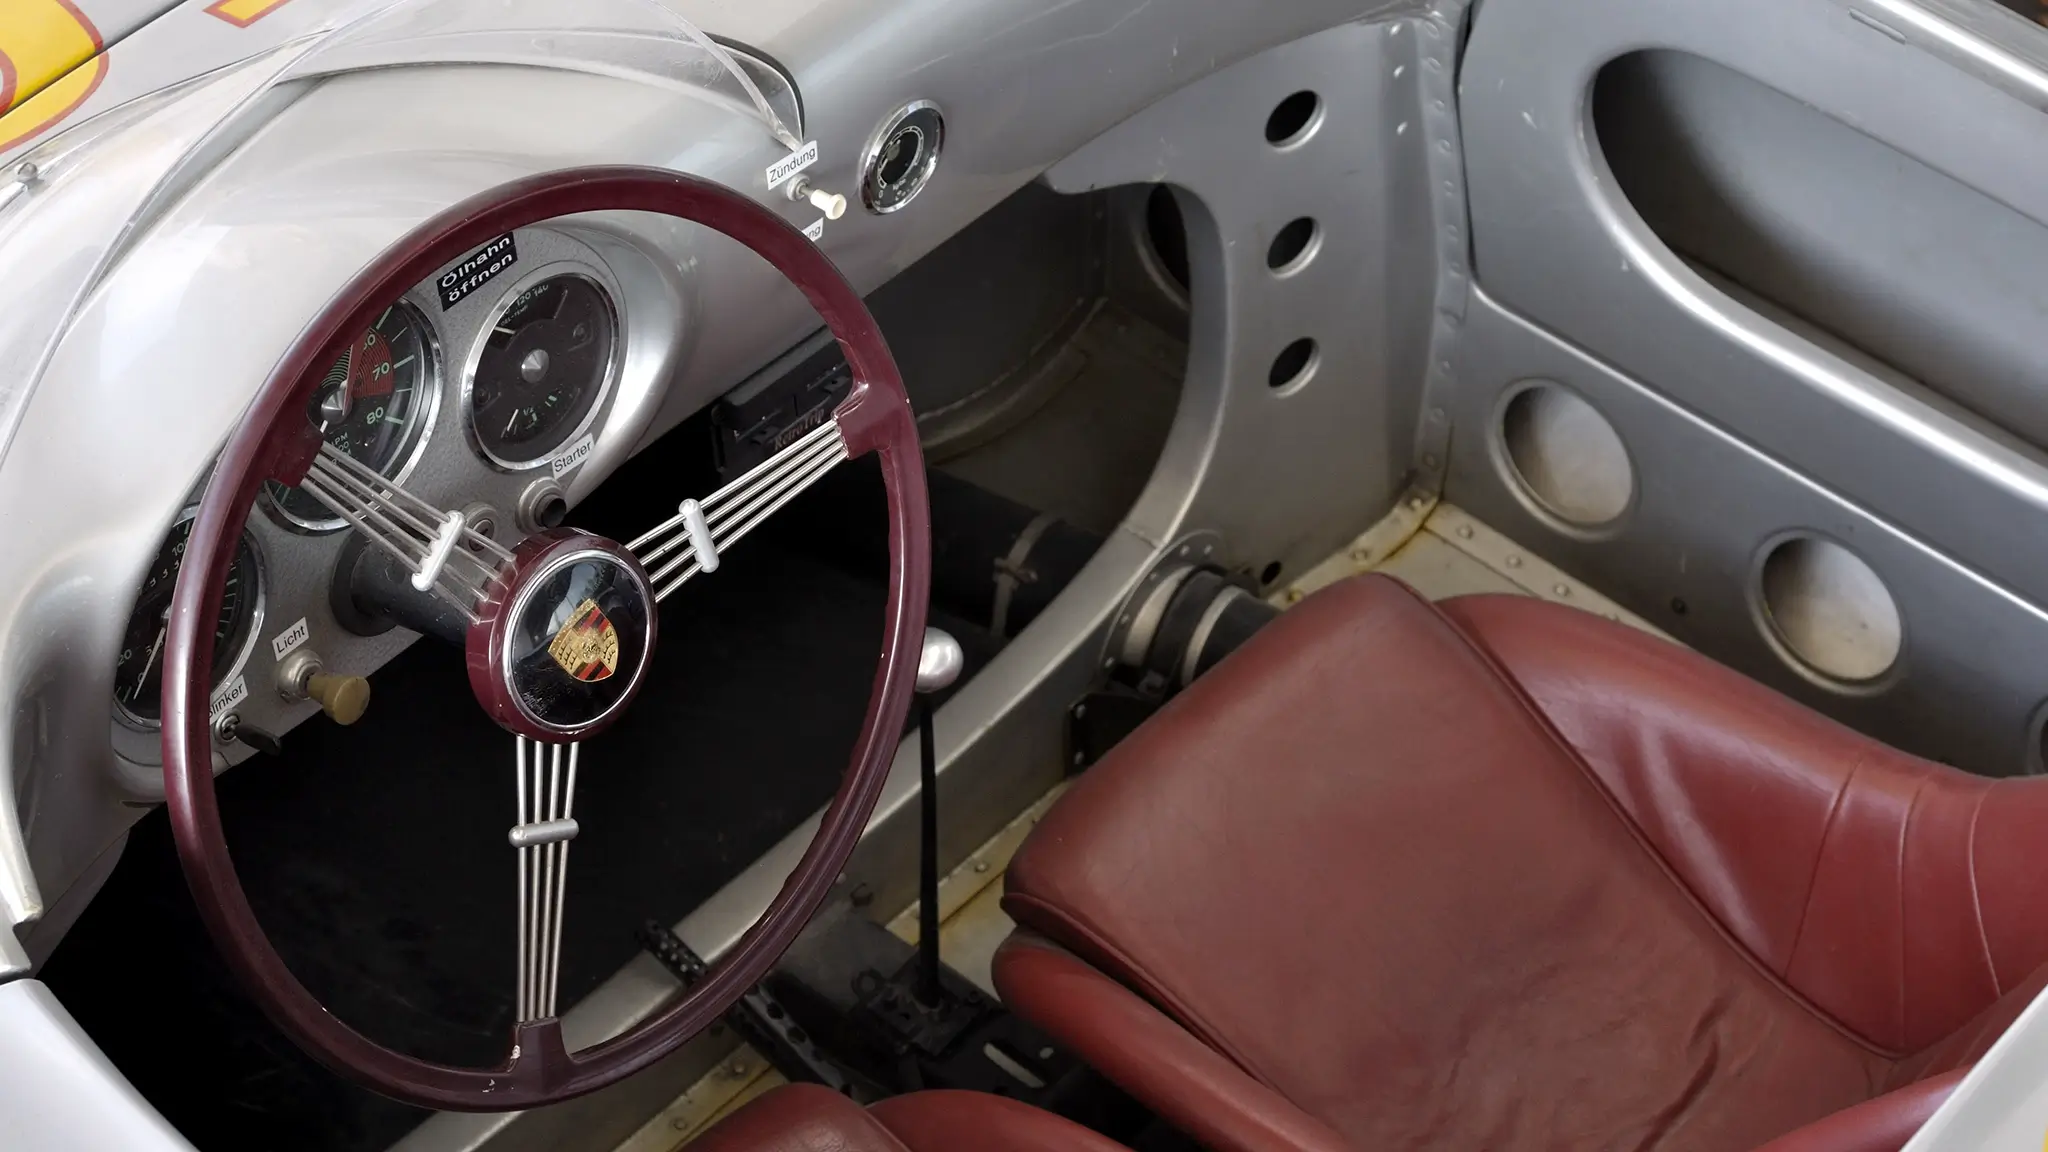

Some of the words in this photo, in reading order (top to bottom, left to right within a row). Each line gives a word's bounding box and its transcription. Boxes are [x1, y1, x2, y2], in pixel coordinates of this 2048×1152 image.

[769, 148, 816, 183] Zündung
[441, 237, 510, 288] Ölhahn
[448, 253, 513, 302] öffnen
[372, 362, 390, 381] 70
[366, 406, 384, 424] 80
[553, 441, 592, 473] Starter
[276, 626, 306, 653] Licht
